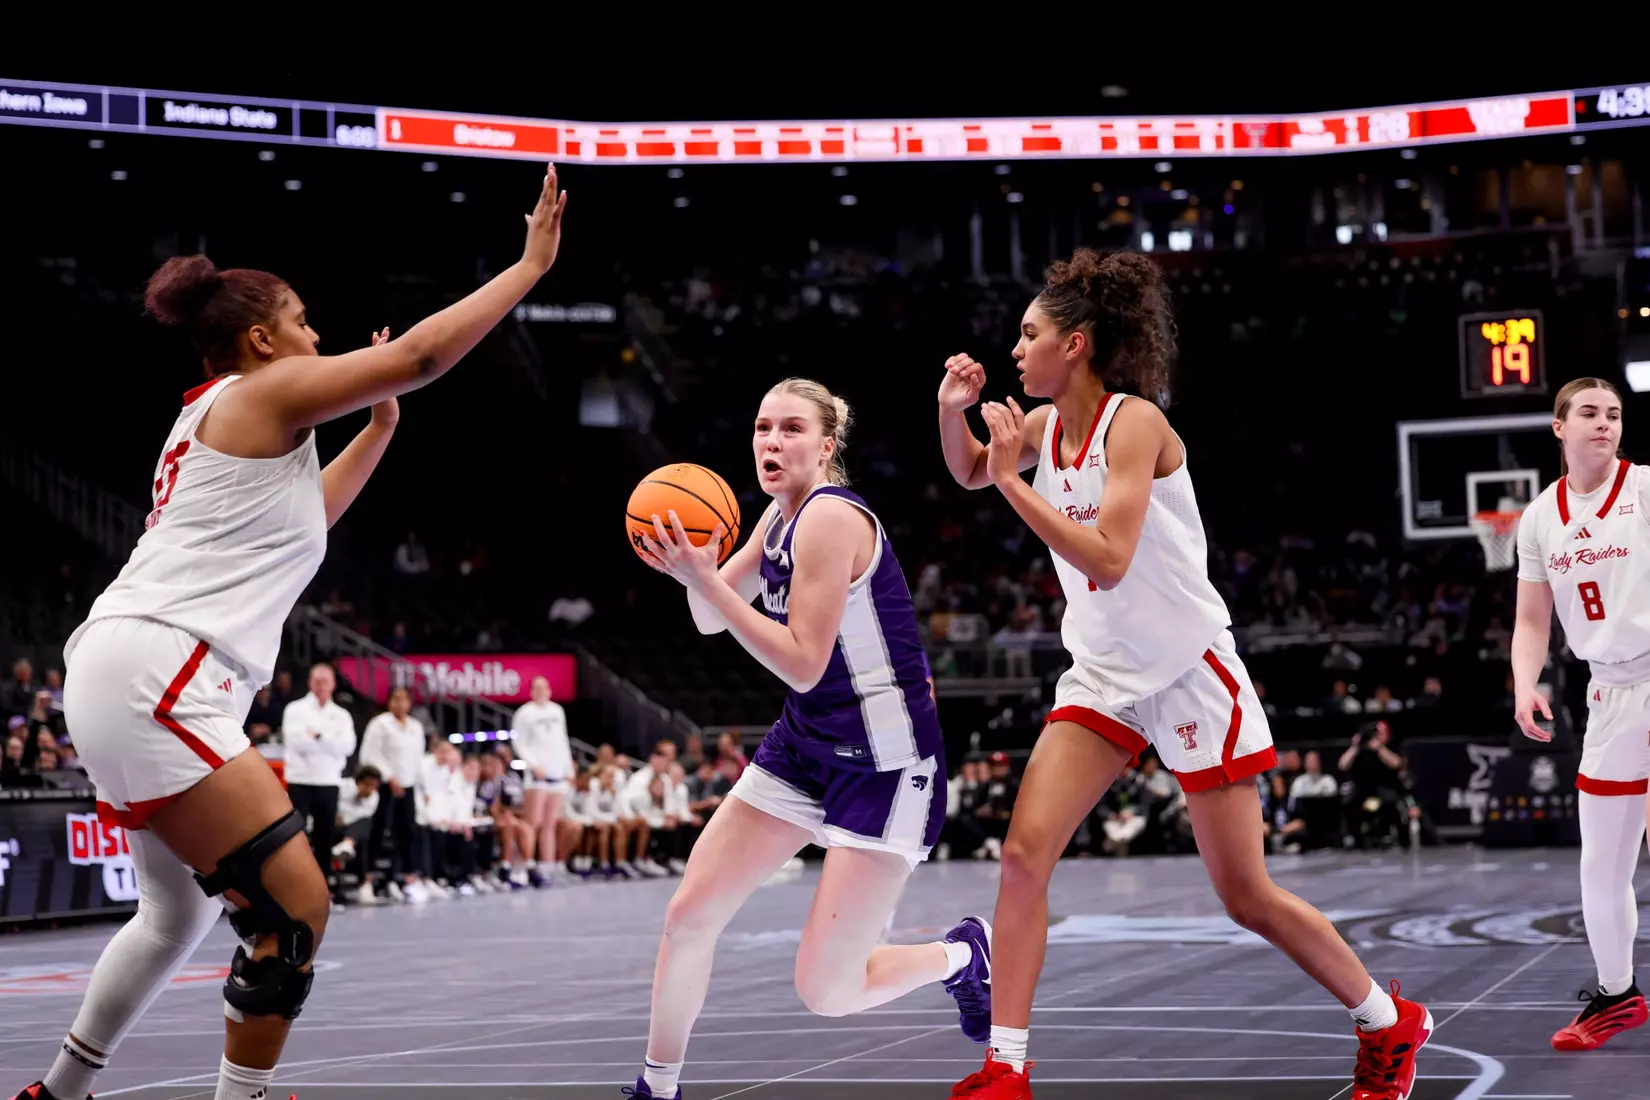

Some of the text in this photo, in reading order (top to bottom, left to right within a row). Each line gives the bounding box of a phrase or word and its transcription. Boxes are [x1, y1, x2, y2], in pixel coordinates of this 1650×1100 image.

[0, 89, 41, 112] hern
[1481, 318, 1536, 345] 4:39
[1491, 343, 1531, 386] 19
[1548, 543, 1630, 574] Lady Raiders
[1577, 581, 1606, 621] 8
